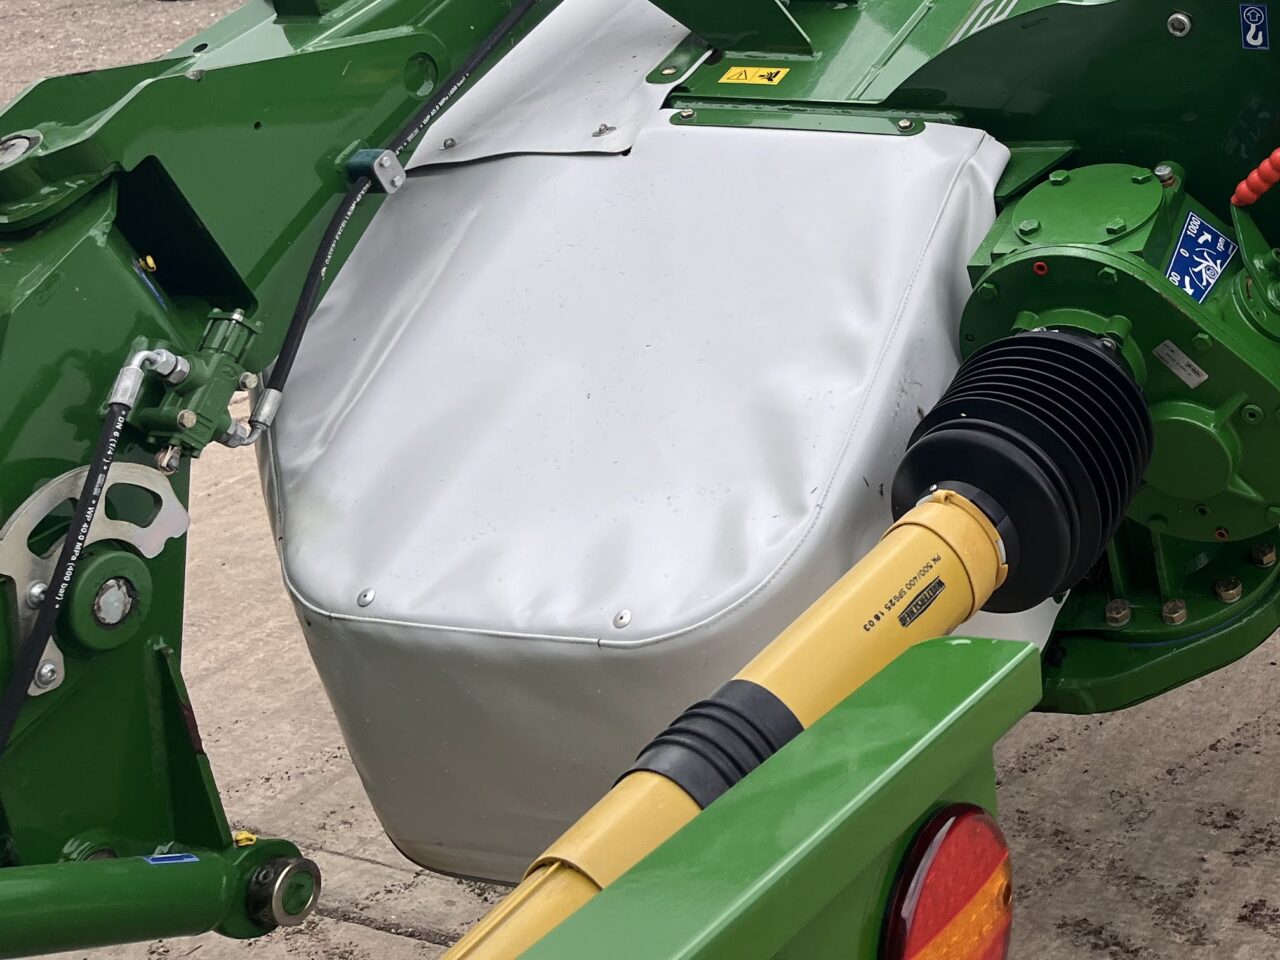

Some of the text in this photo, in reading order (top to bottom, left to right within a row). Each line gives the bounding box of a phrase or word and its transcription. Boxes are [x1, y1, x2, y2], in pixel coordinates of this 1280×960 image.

[1186, 216, 1201, 238] 1000
[1216, 236, 1226, 252] rpm
[1180, 248, 1190, 258] 0
[1168, 271, 1181, 286] 00
[116, 416, 125, 430] DN
[55, 506, 95, 601] WP 40.0 MPa (400 bar)
